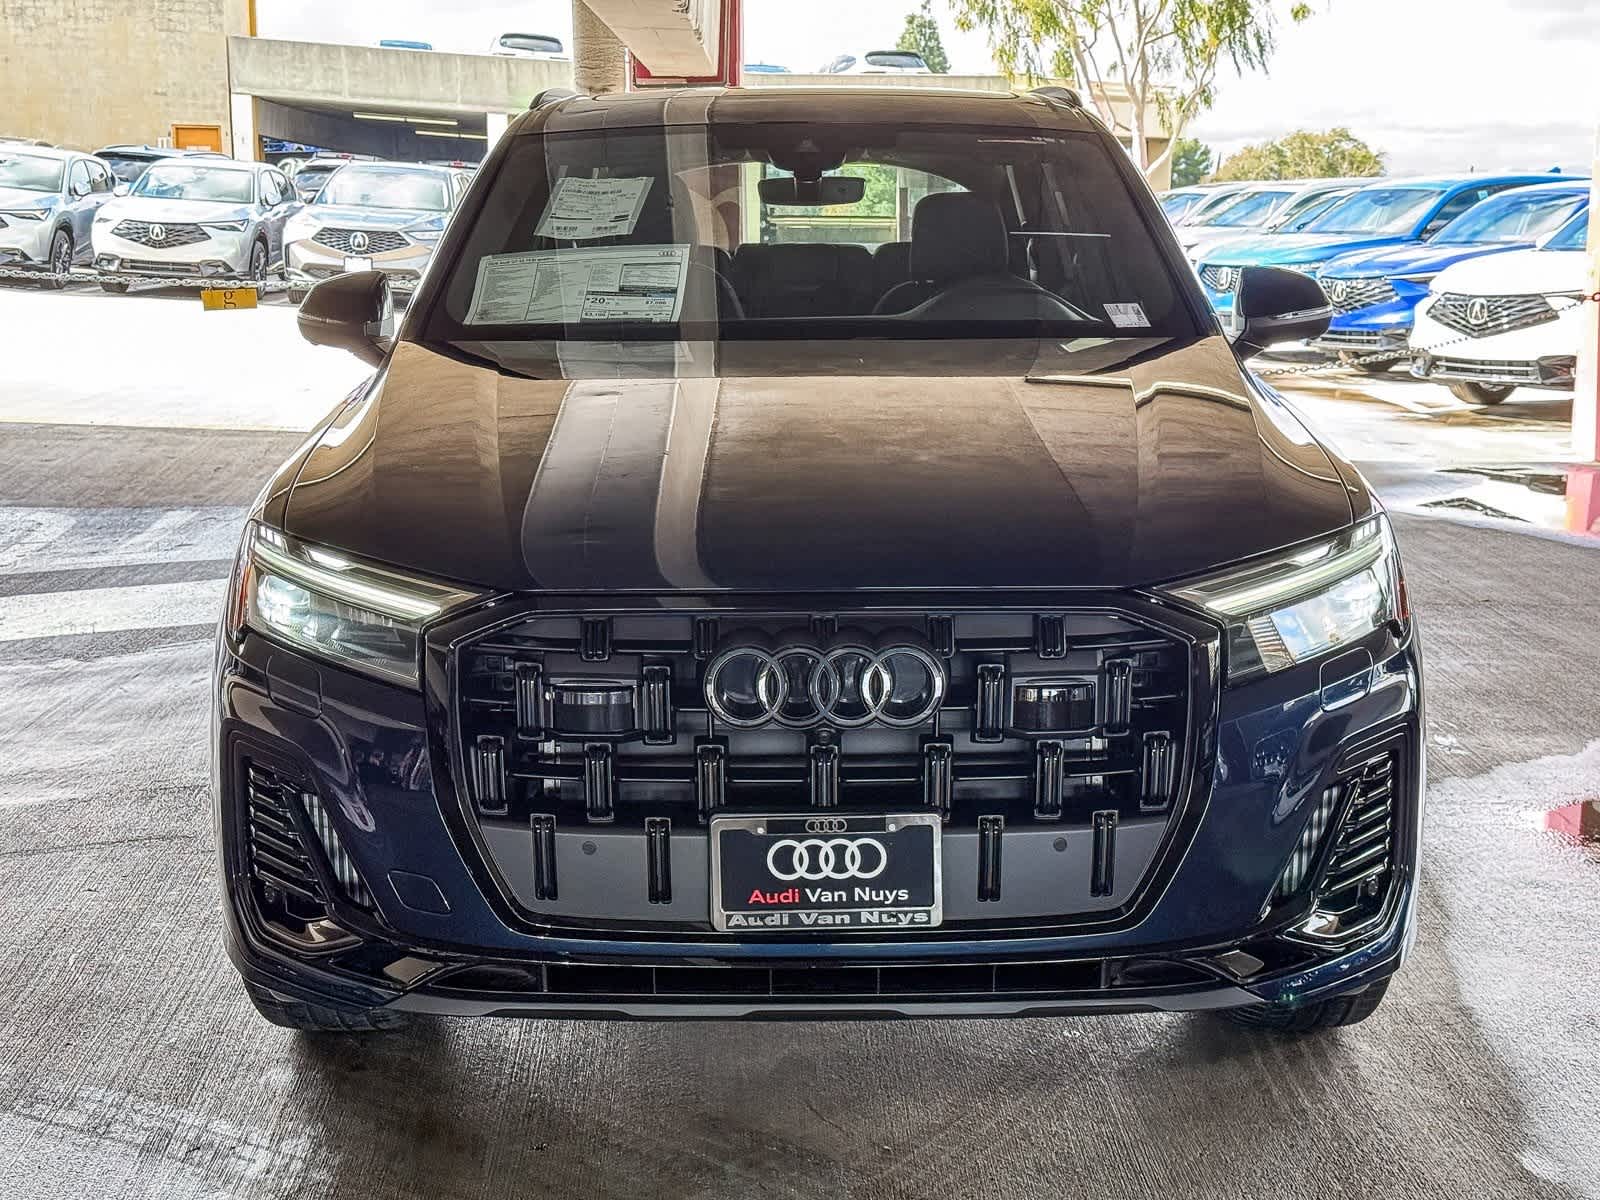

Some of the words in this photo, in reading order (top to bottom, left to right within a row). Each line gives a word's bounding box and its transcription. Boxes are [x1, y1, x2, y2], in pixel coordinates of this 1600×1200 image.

[590, 297, 606, 305] 20
[748, 888, 800, 904] Audi
[805, 888, 847, 903] Van
[854, 887, 909, 905] Nuys
[728, 912, 789, 926] Audi
[798, 912, 851, 925] Van
[860, 911, 929, 926] Nuys
